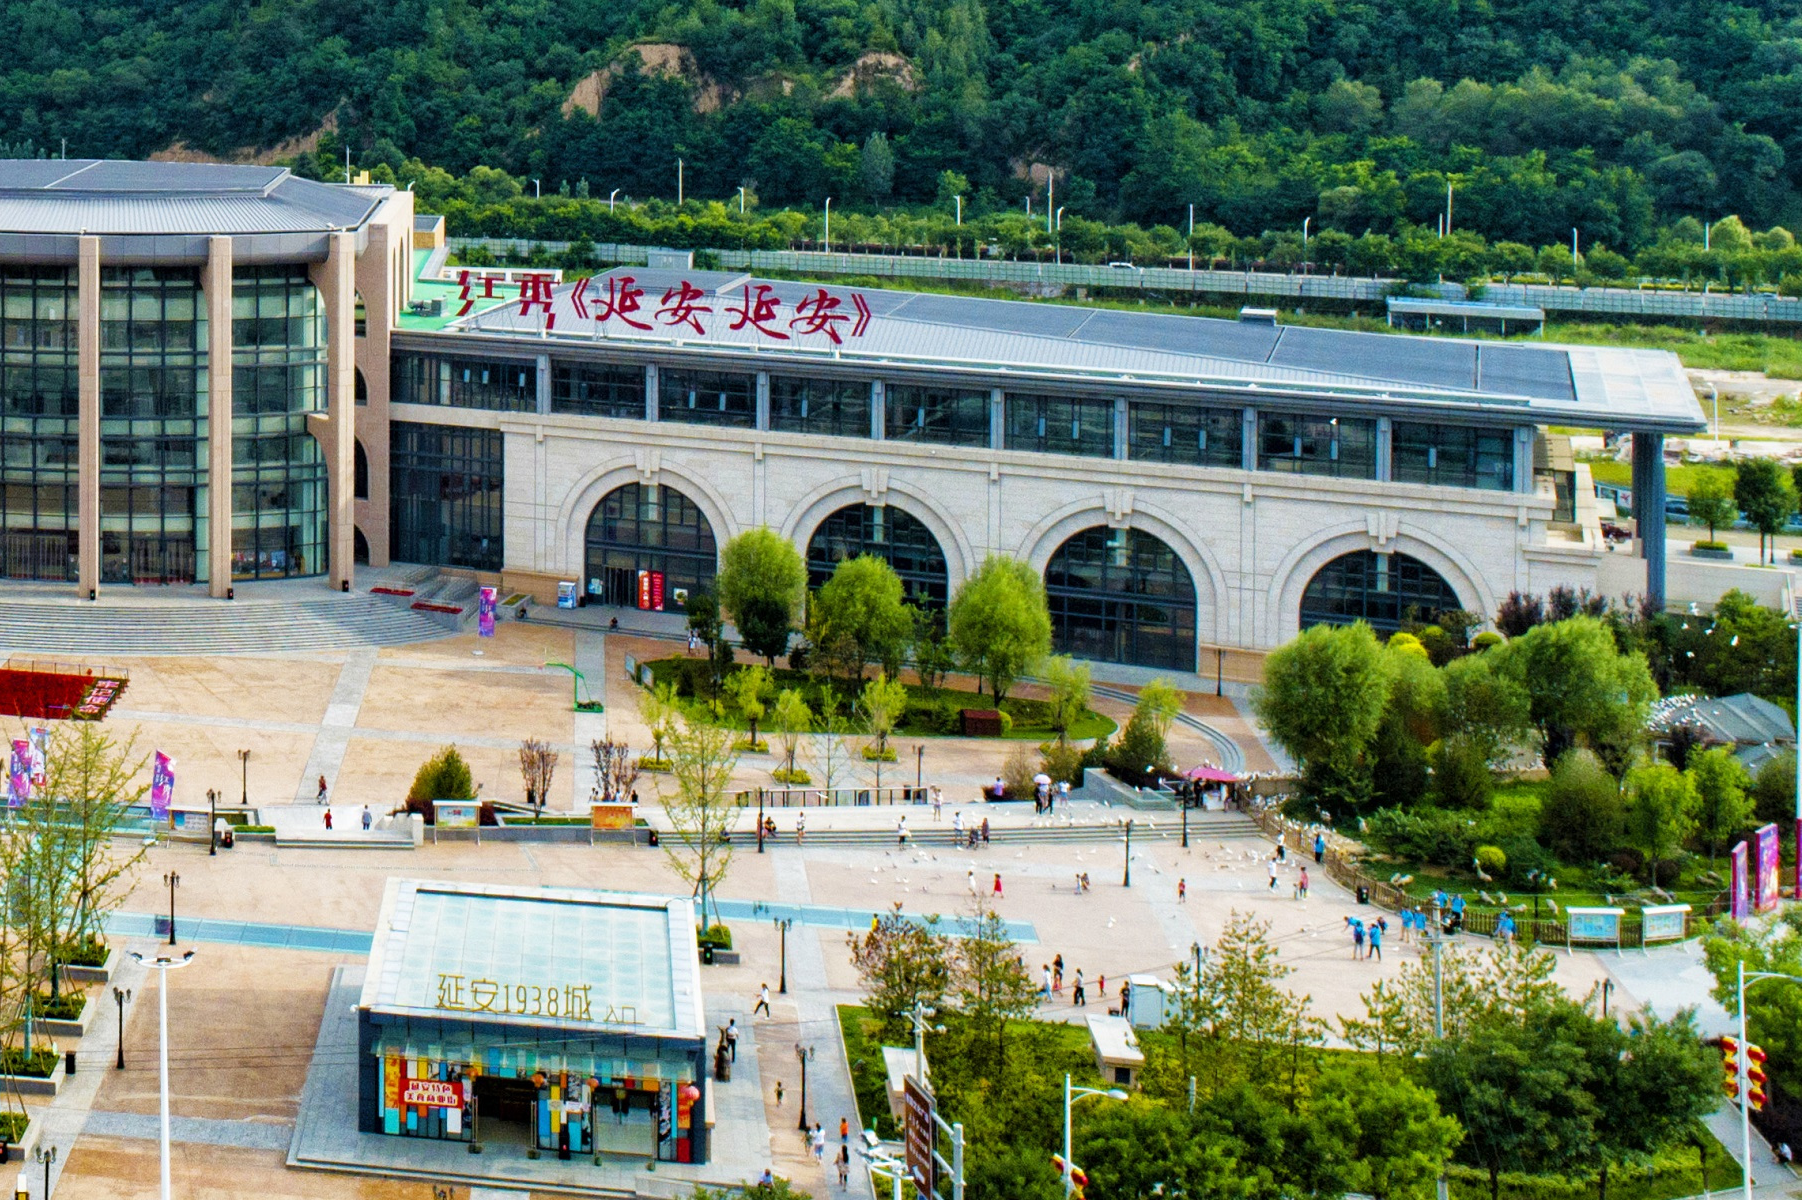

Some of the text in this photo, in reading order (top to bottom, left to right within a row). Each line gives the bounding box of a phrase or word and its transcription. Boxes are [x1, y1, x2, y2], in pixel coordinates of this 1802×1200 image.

[79, 680, 120, 714] 牢记使命
[434, 973, 637, 1025] 延安1938城 入口
